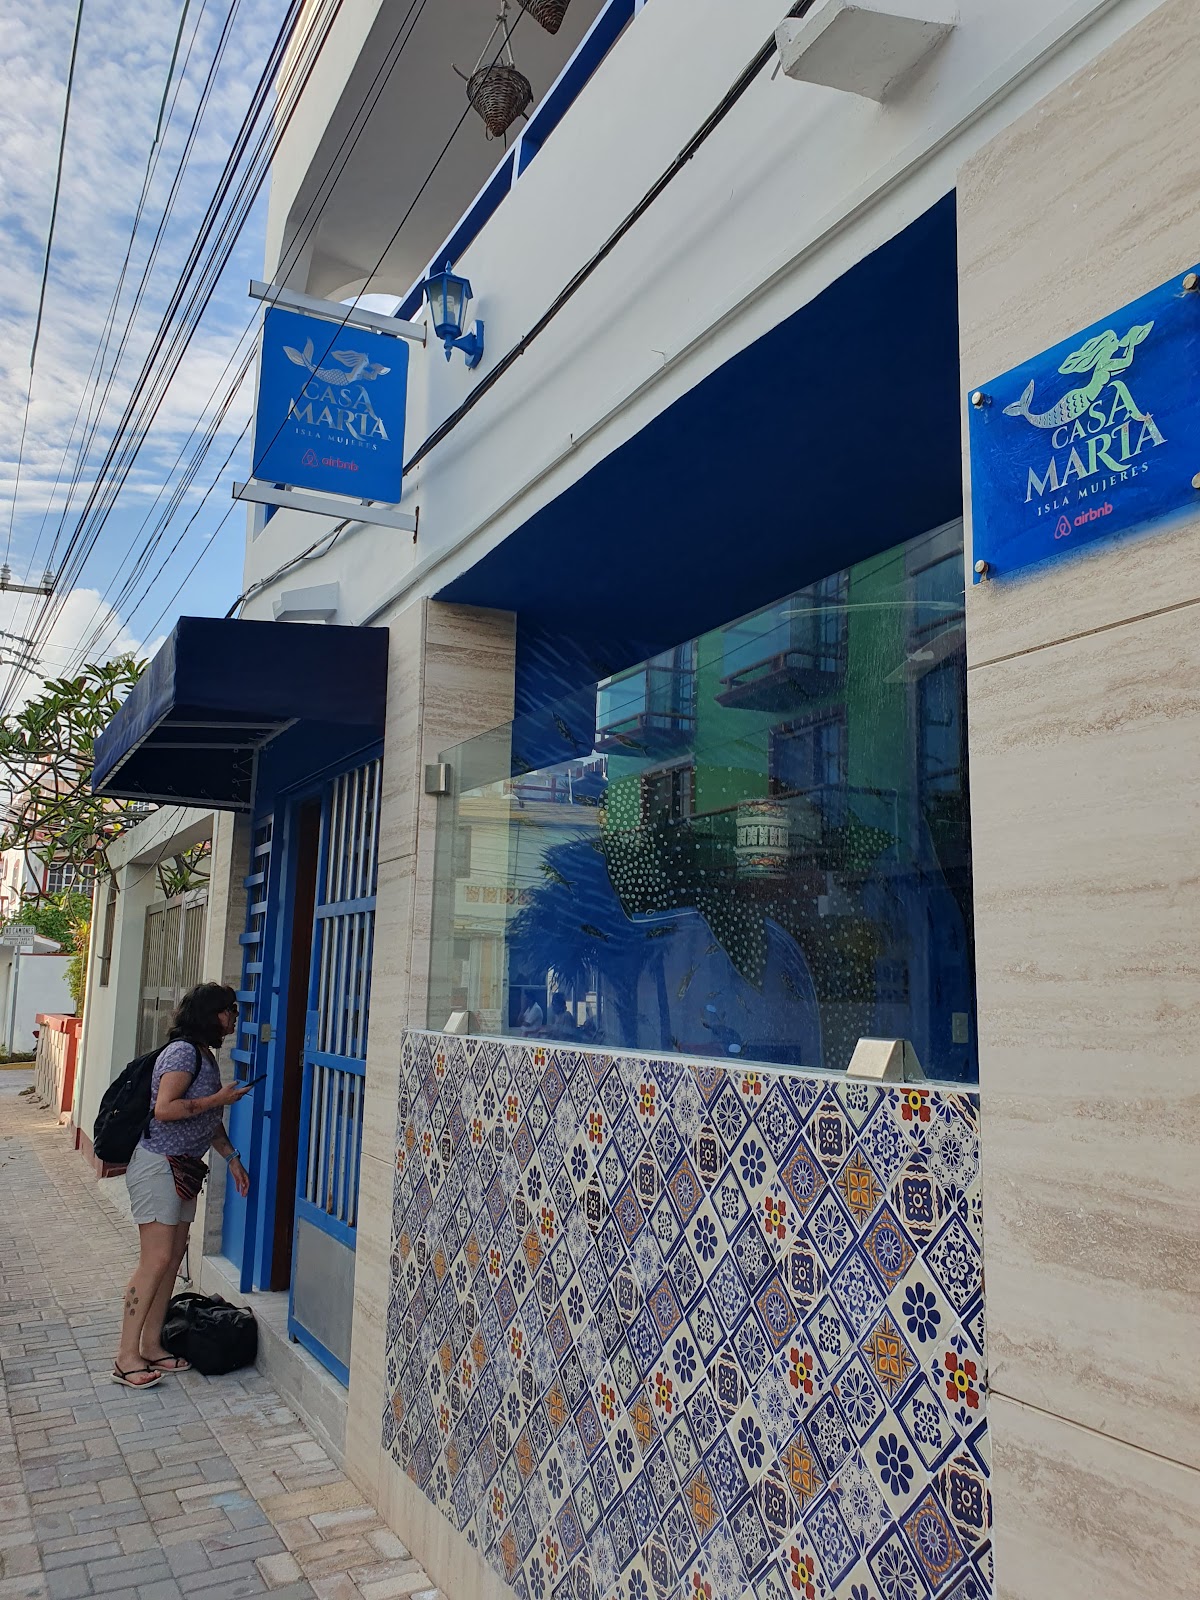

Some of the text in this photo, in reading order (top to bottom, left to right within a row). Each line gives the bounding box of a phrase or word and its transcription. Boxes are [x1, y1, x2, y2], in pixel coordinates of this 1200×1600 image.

[301, 382, 378, 420] CASA
[1051, 380, 1143, 449] CASA
[295, 428, 377, 451] ISLA MUJERES
[322, 456, 359, 472] airbnb
[1037, 462, 1149, 517] ISLA MUJERES
[1074, 502, 1113, 528] airbnb
